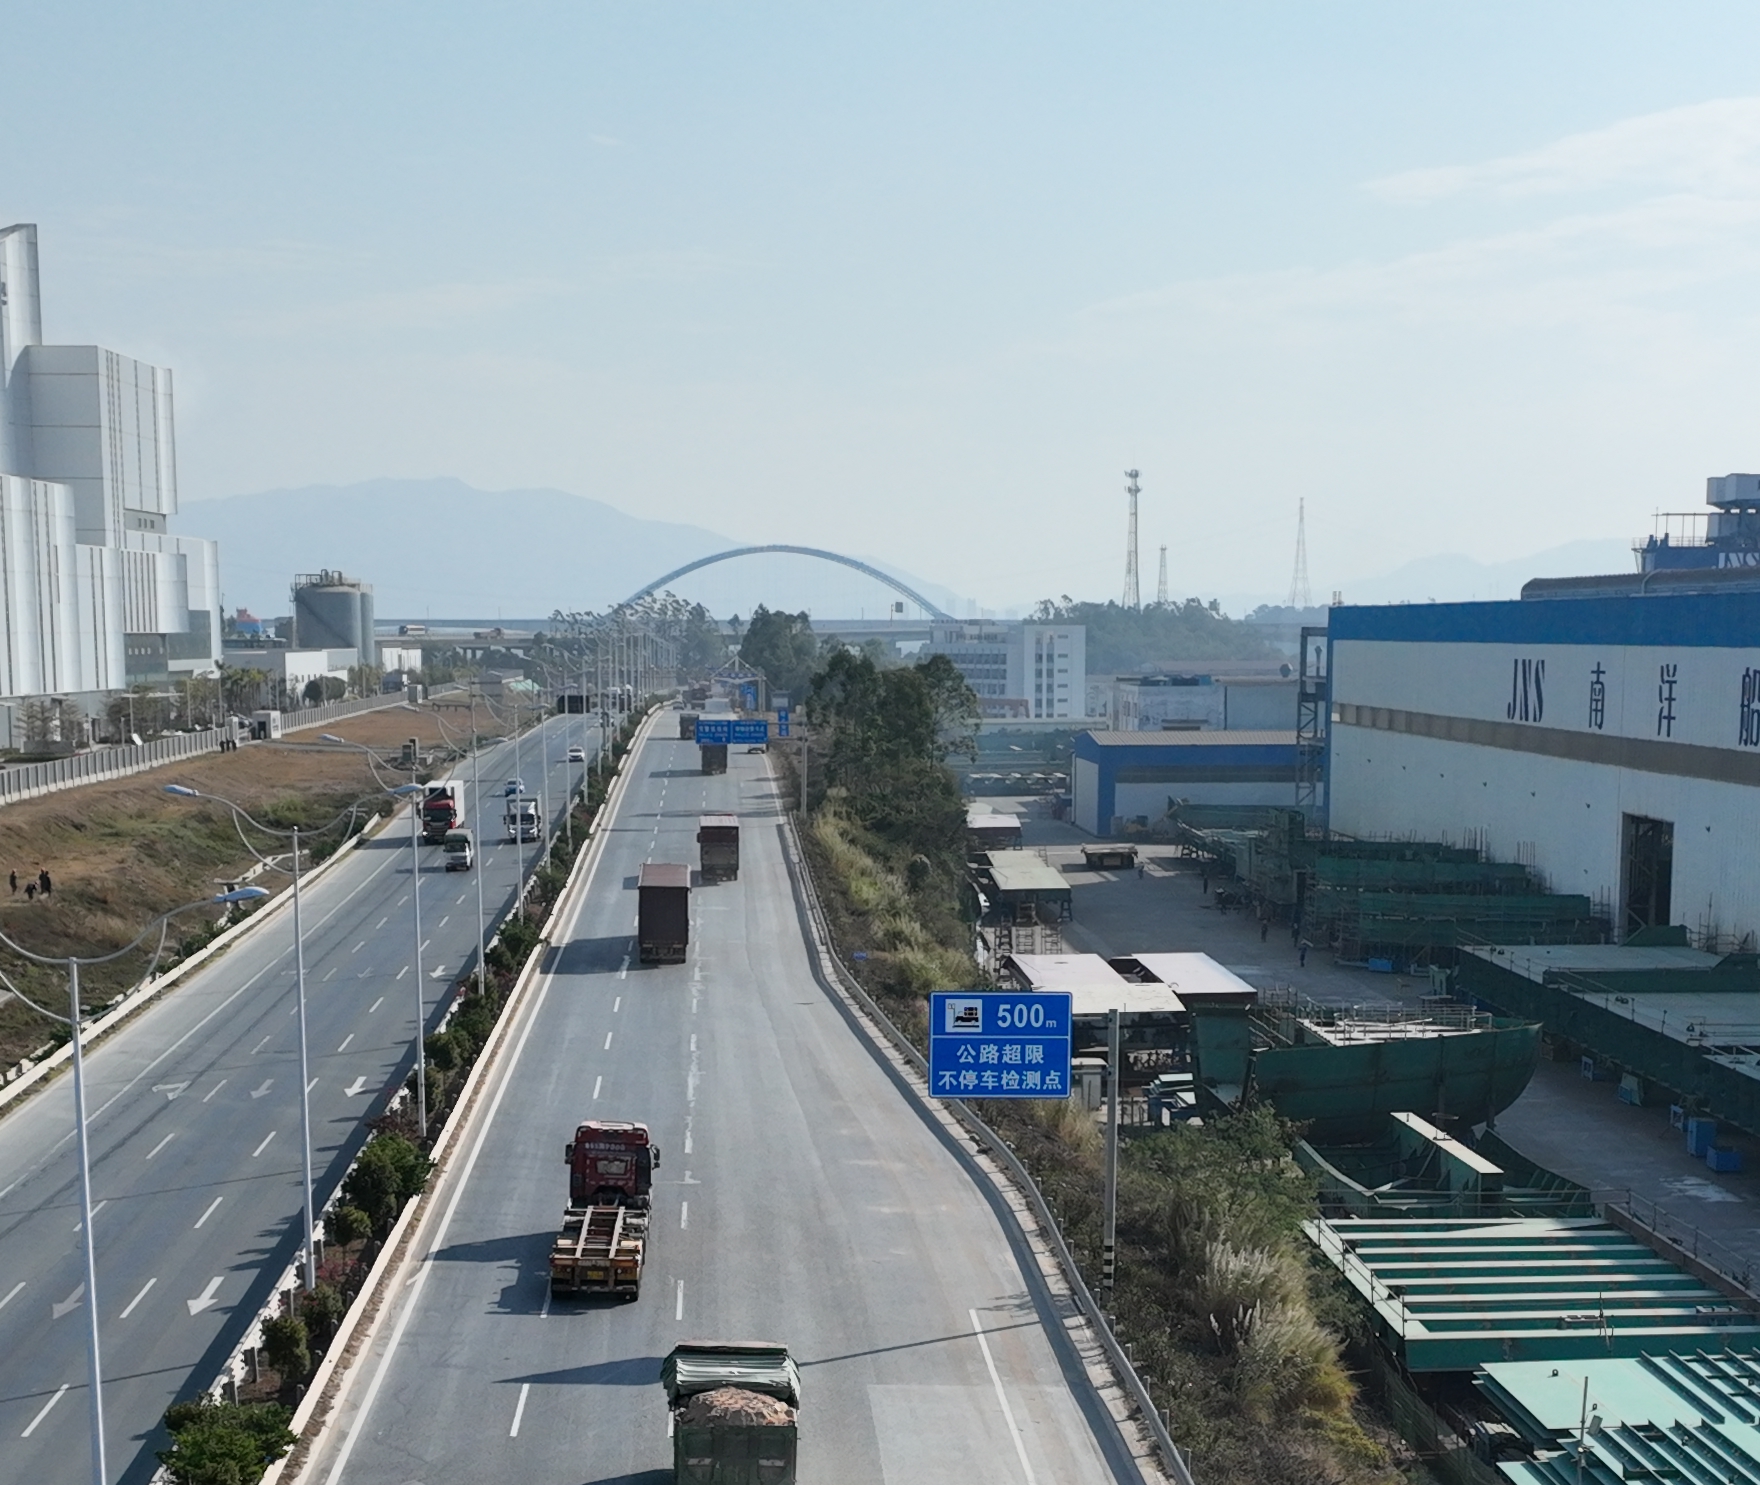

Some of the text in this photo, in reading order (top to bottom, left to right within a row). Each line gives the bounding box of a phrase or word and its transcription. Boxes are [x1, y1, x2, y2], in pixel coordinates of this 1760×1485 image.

[1507, 658, 1546, 723] JNS
[956, 1044, 1045, 1064] 公路超限
[938, 1070, 1062, 1090] 不停车检测点
